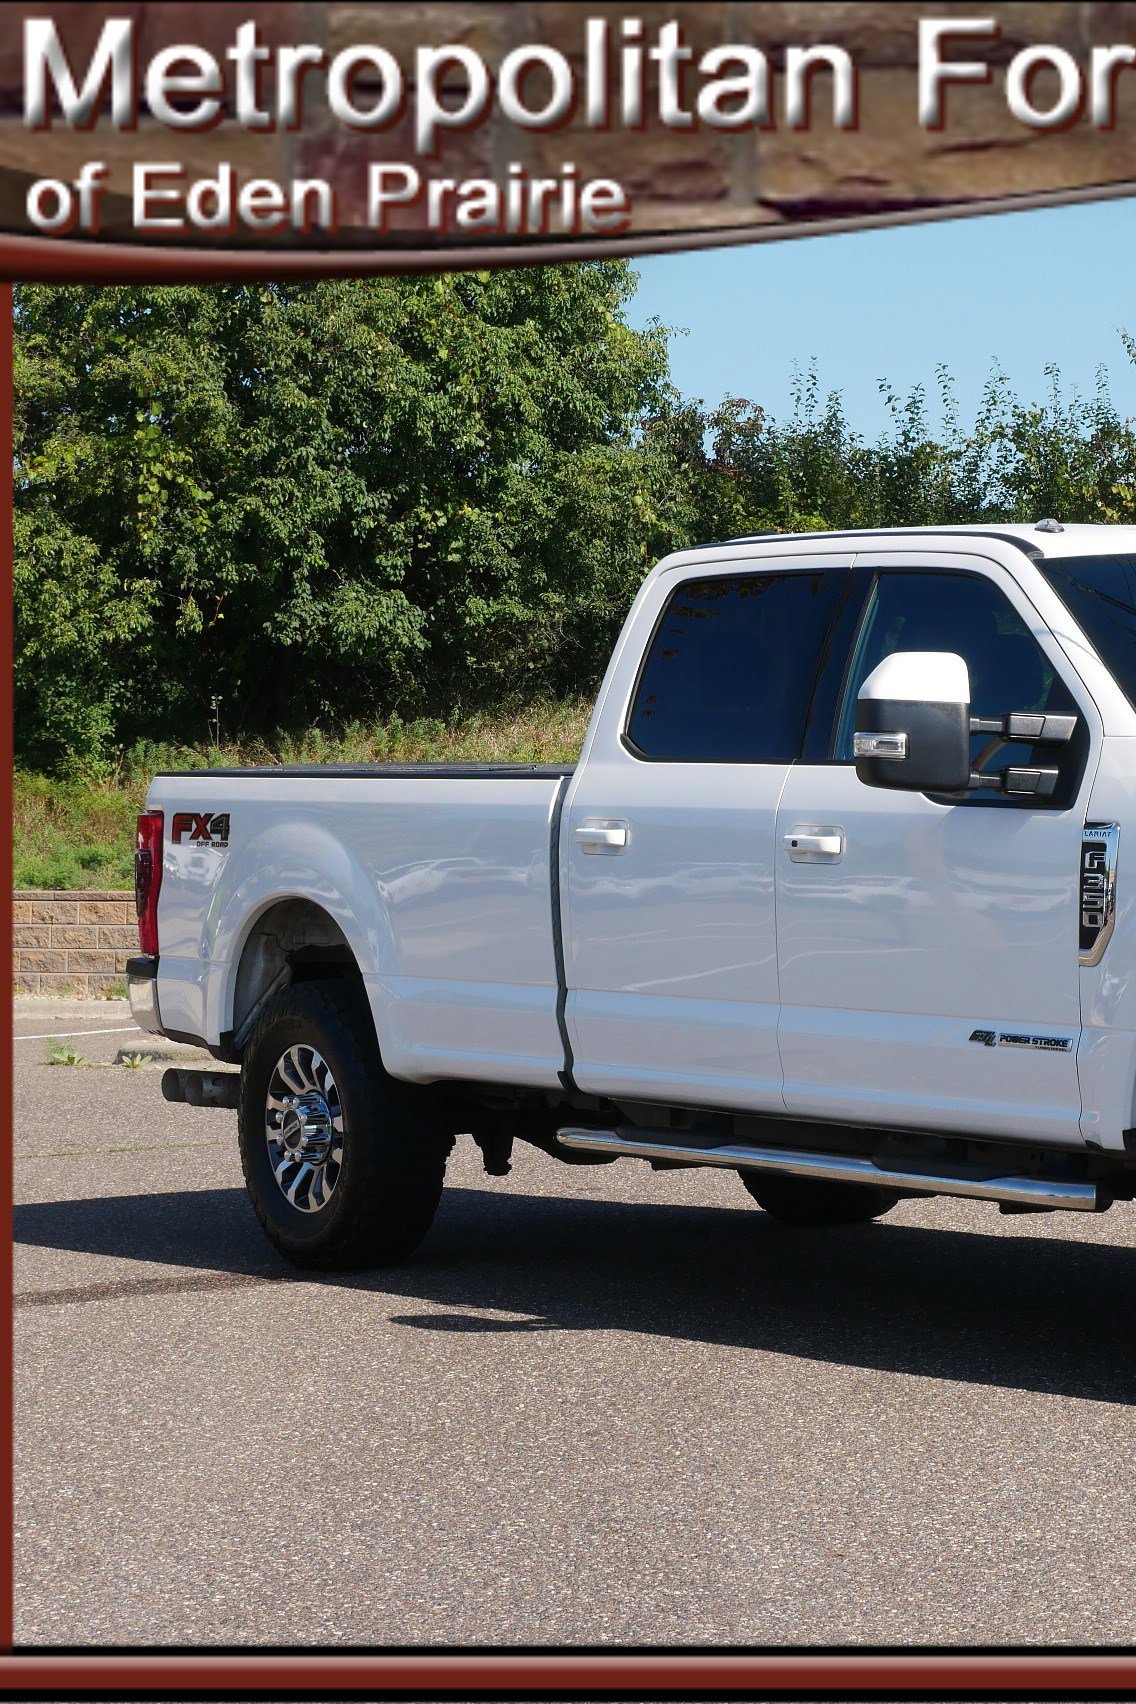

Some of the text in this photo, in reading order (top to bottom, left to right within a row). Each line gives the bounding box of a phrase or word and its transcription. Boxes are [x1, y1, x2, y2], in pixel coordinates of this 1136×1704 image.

[172, 813, 230, 844] FX4
[1084, 829, 1112, 837] LARIAT
[1000, 1034, 1069, 1047] POWER STROKE
